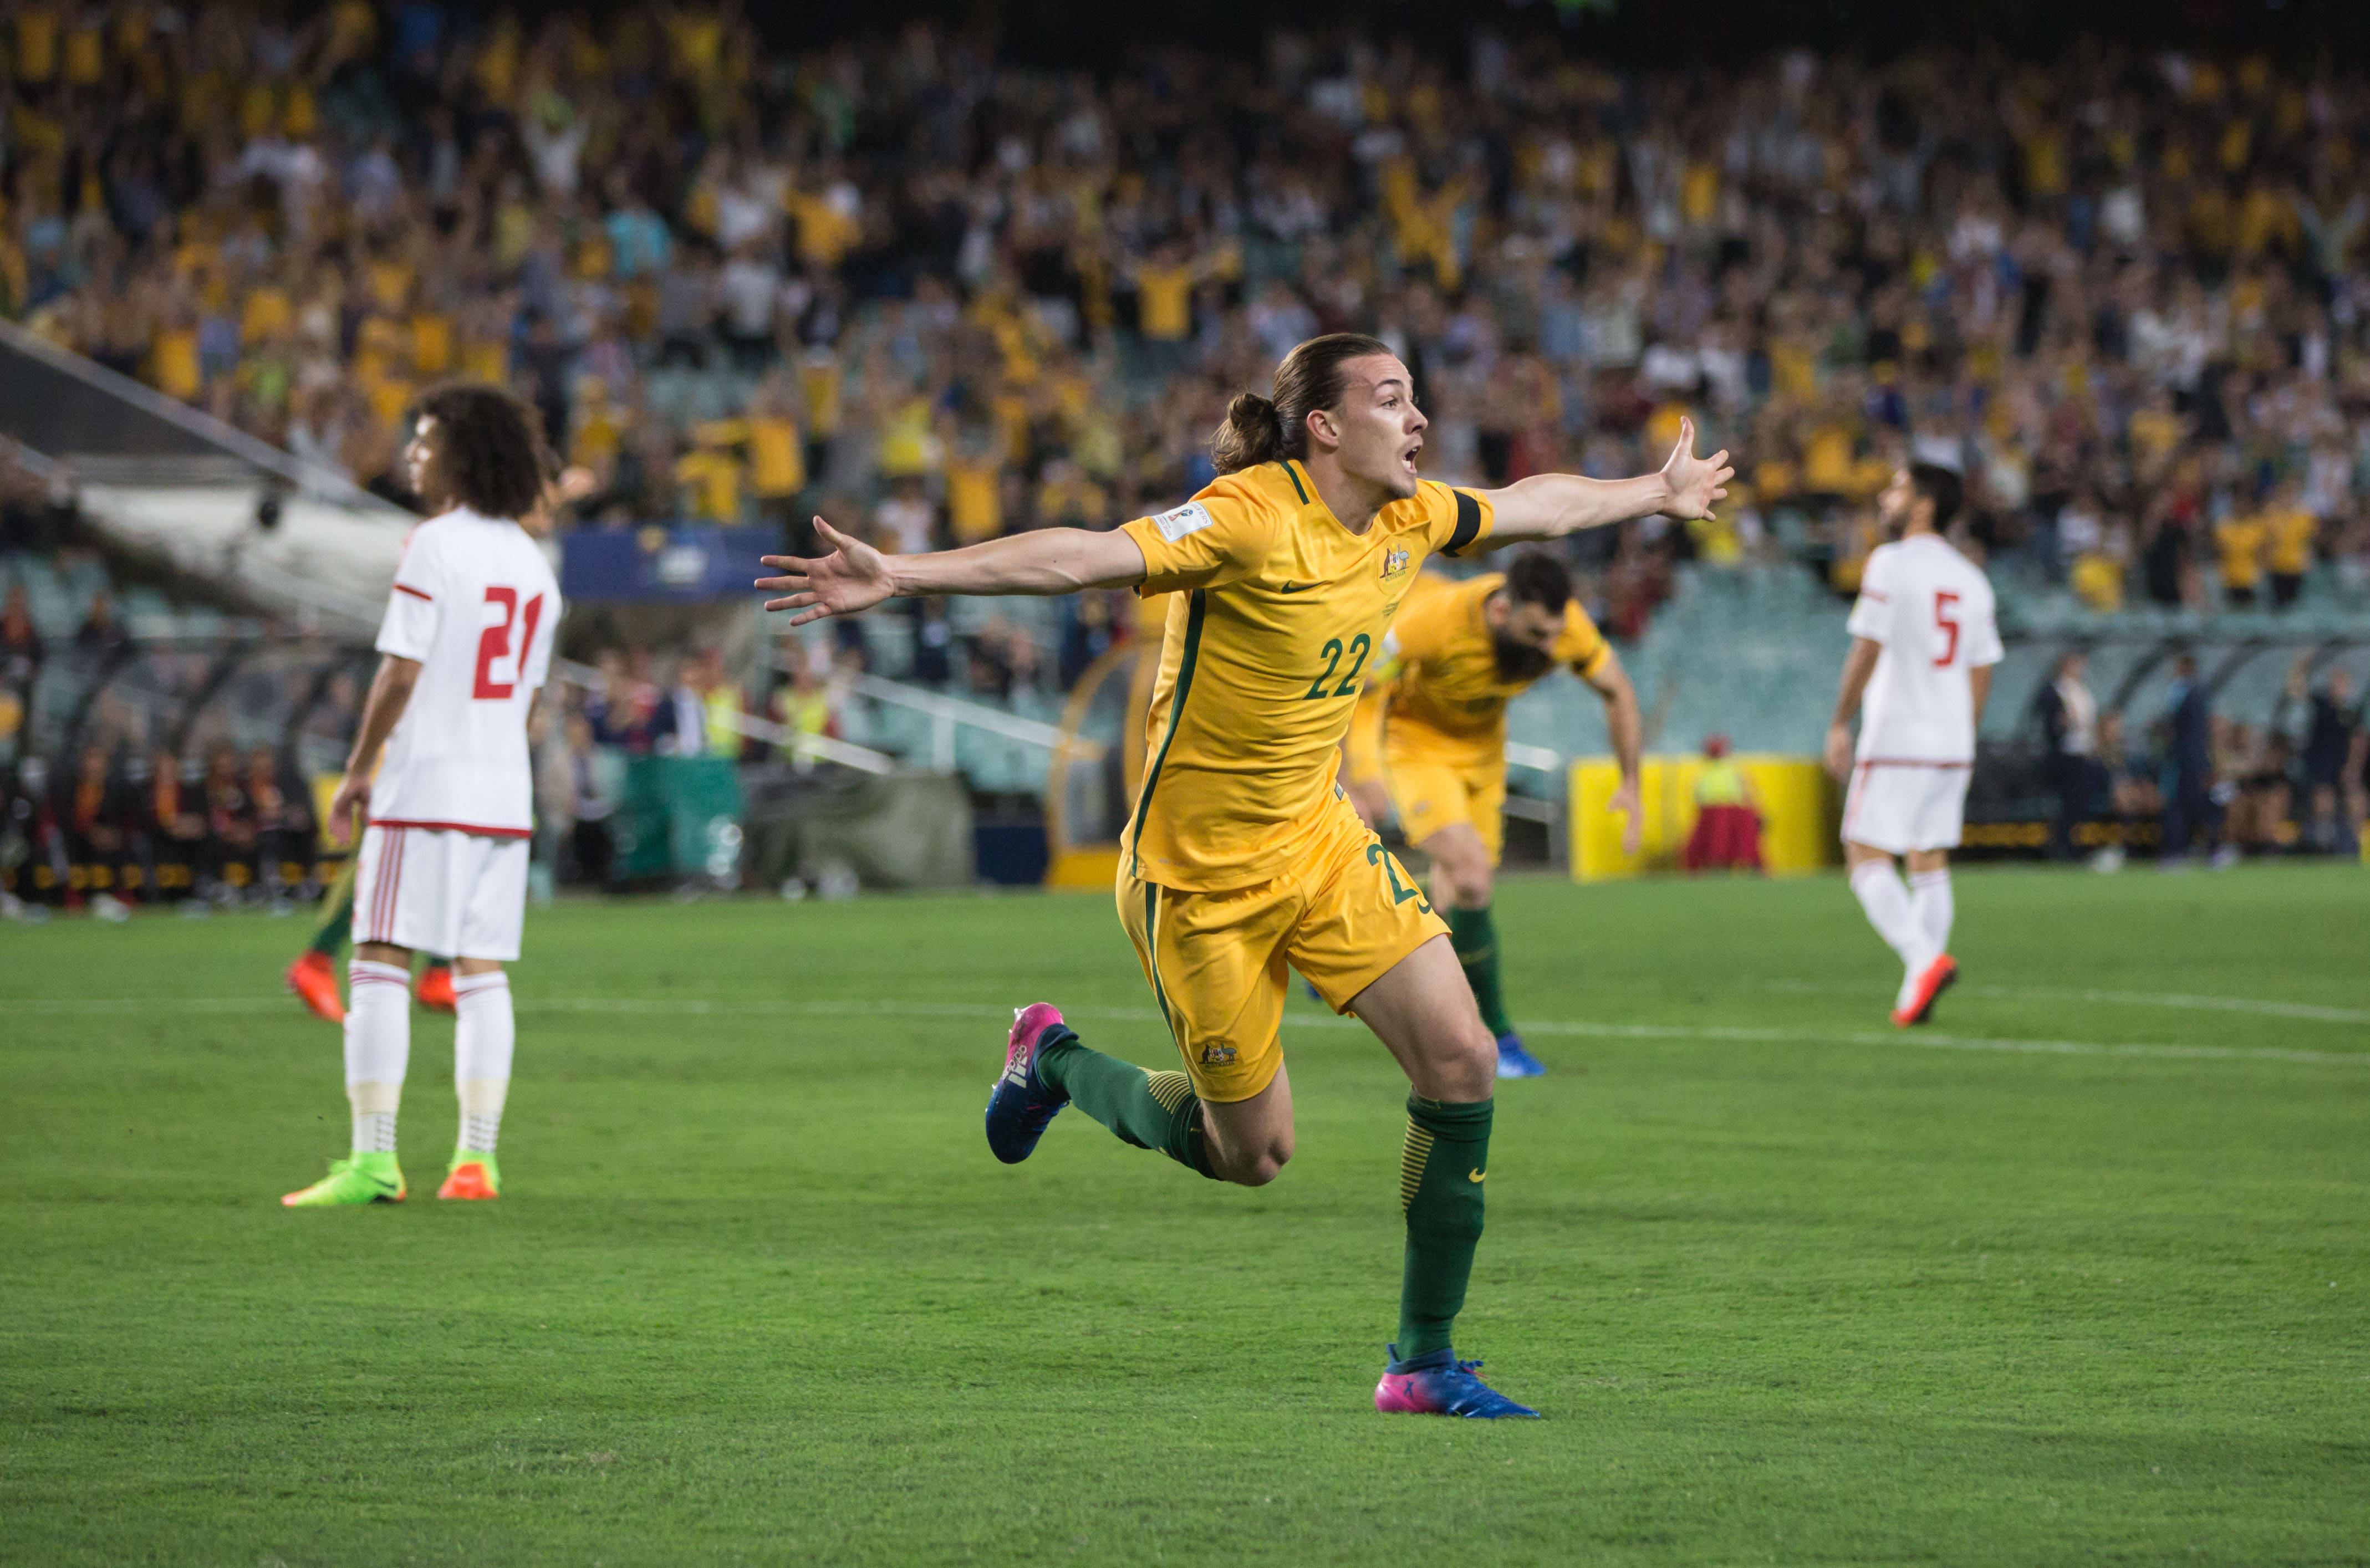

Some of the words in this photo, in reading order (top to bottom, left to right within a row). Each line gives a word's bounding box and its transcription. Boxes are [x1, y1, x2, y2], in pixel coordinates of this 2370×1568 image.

[472, 586, 543, 699] 21
[1933, 591, 1959, 666] 5
[1303, 633, 1370, 700] 22
